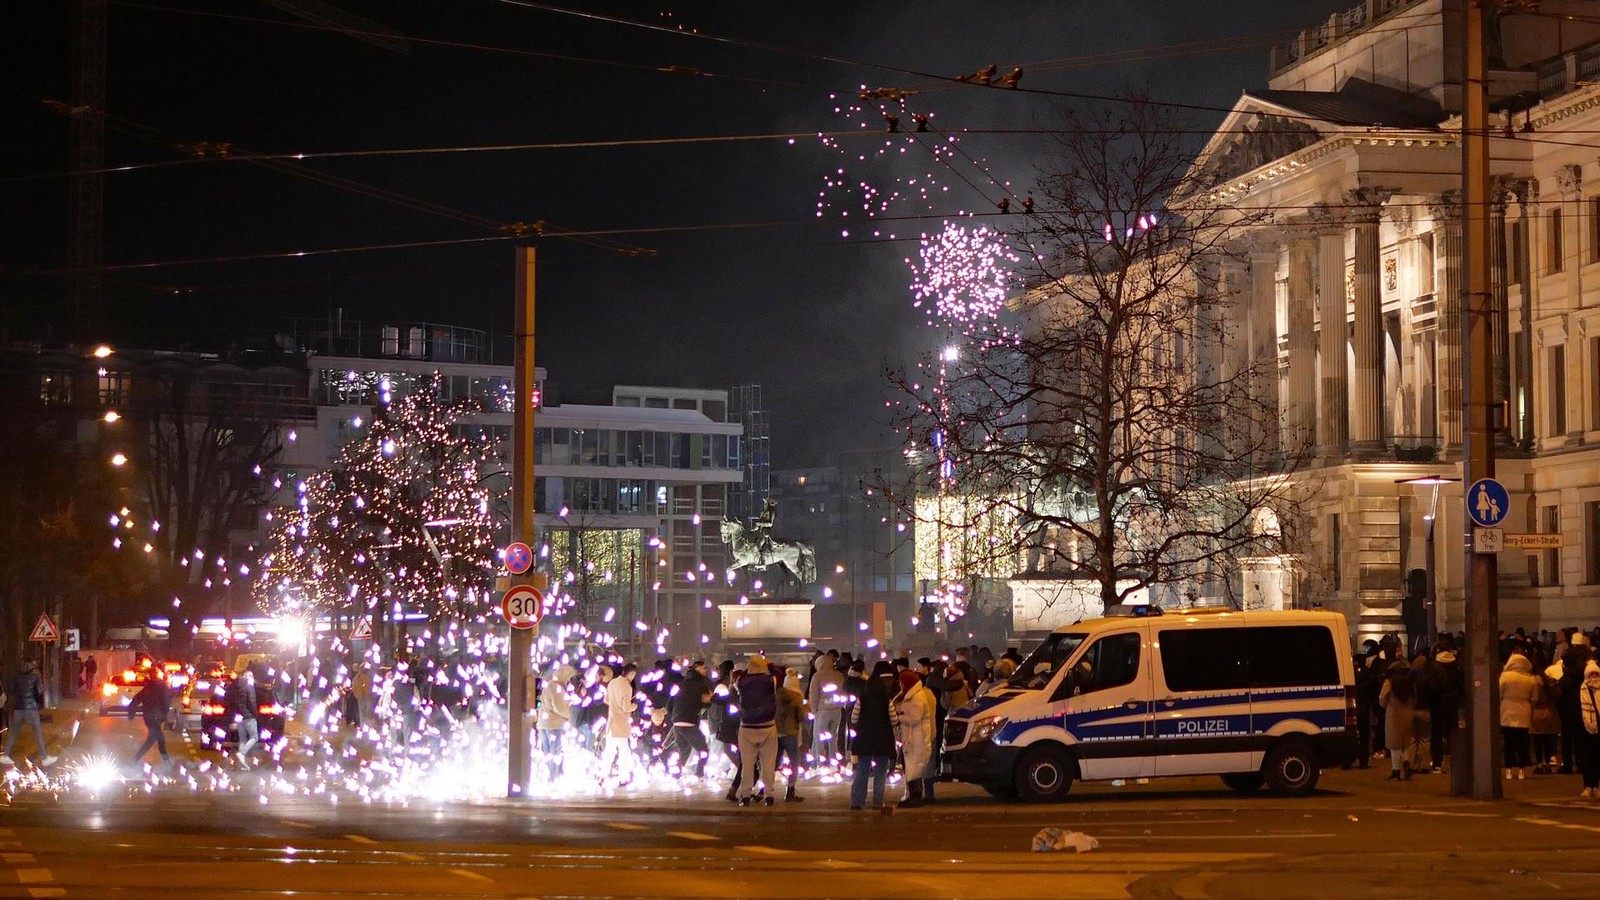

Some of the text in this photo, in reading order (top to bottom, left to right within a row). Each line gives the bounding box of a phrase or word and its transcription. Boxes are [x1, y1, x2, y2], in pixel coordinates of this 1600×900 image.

[1503, 536, 1559, 546] eorg-Eckert-Straße
[511, 597, 535, 616] 30
[1178, 719, 1229, 733] POLIZEI
